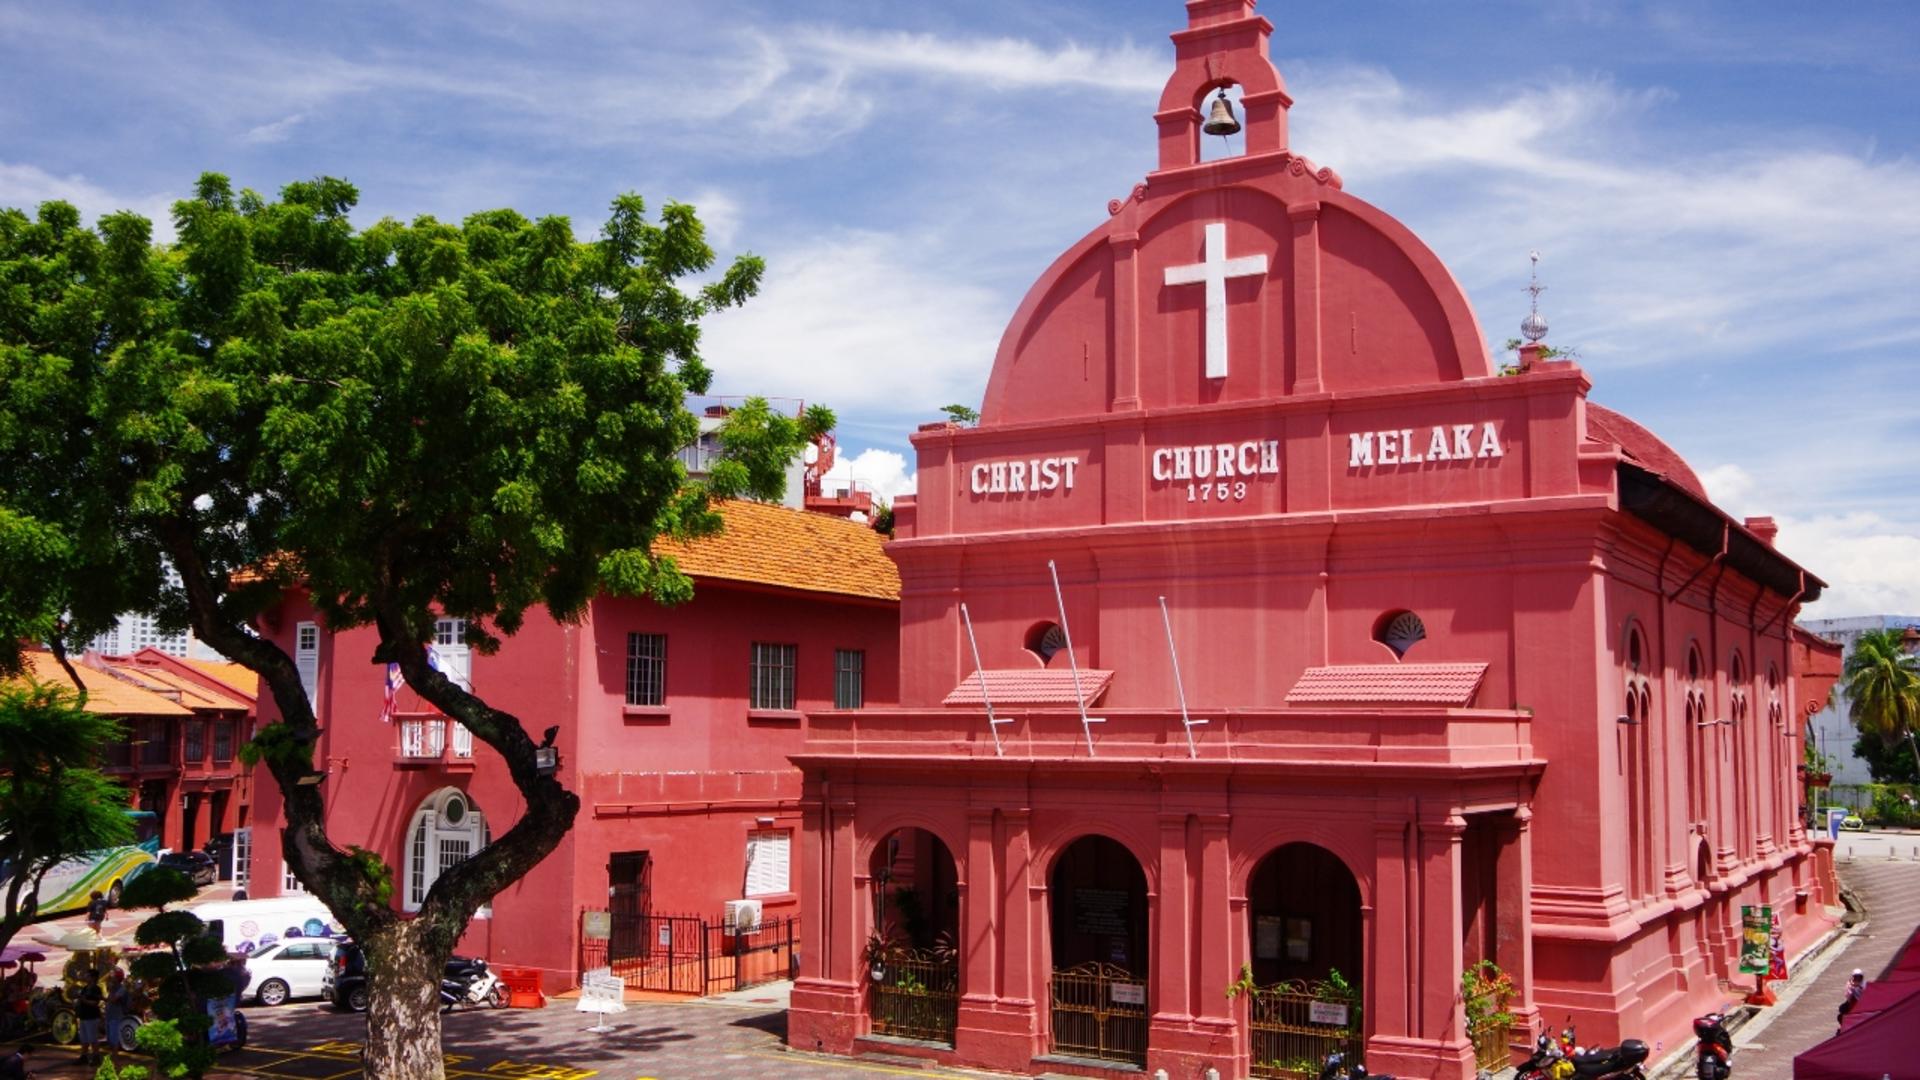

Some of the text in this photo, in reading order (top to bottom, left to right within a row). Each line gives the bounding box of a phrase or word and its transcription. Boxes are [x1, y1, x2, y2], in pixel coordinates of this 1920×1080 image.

[971, 421, 1504, 494] CHRIST CHURCH MELAKA
[1186, 482, 1247, 502] 1753
